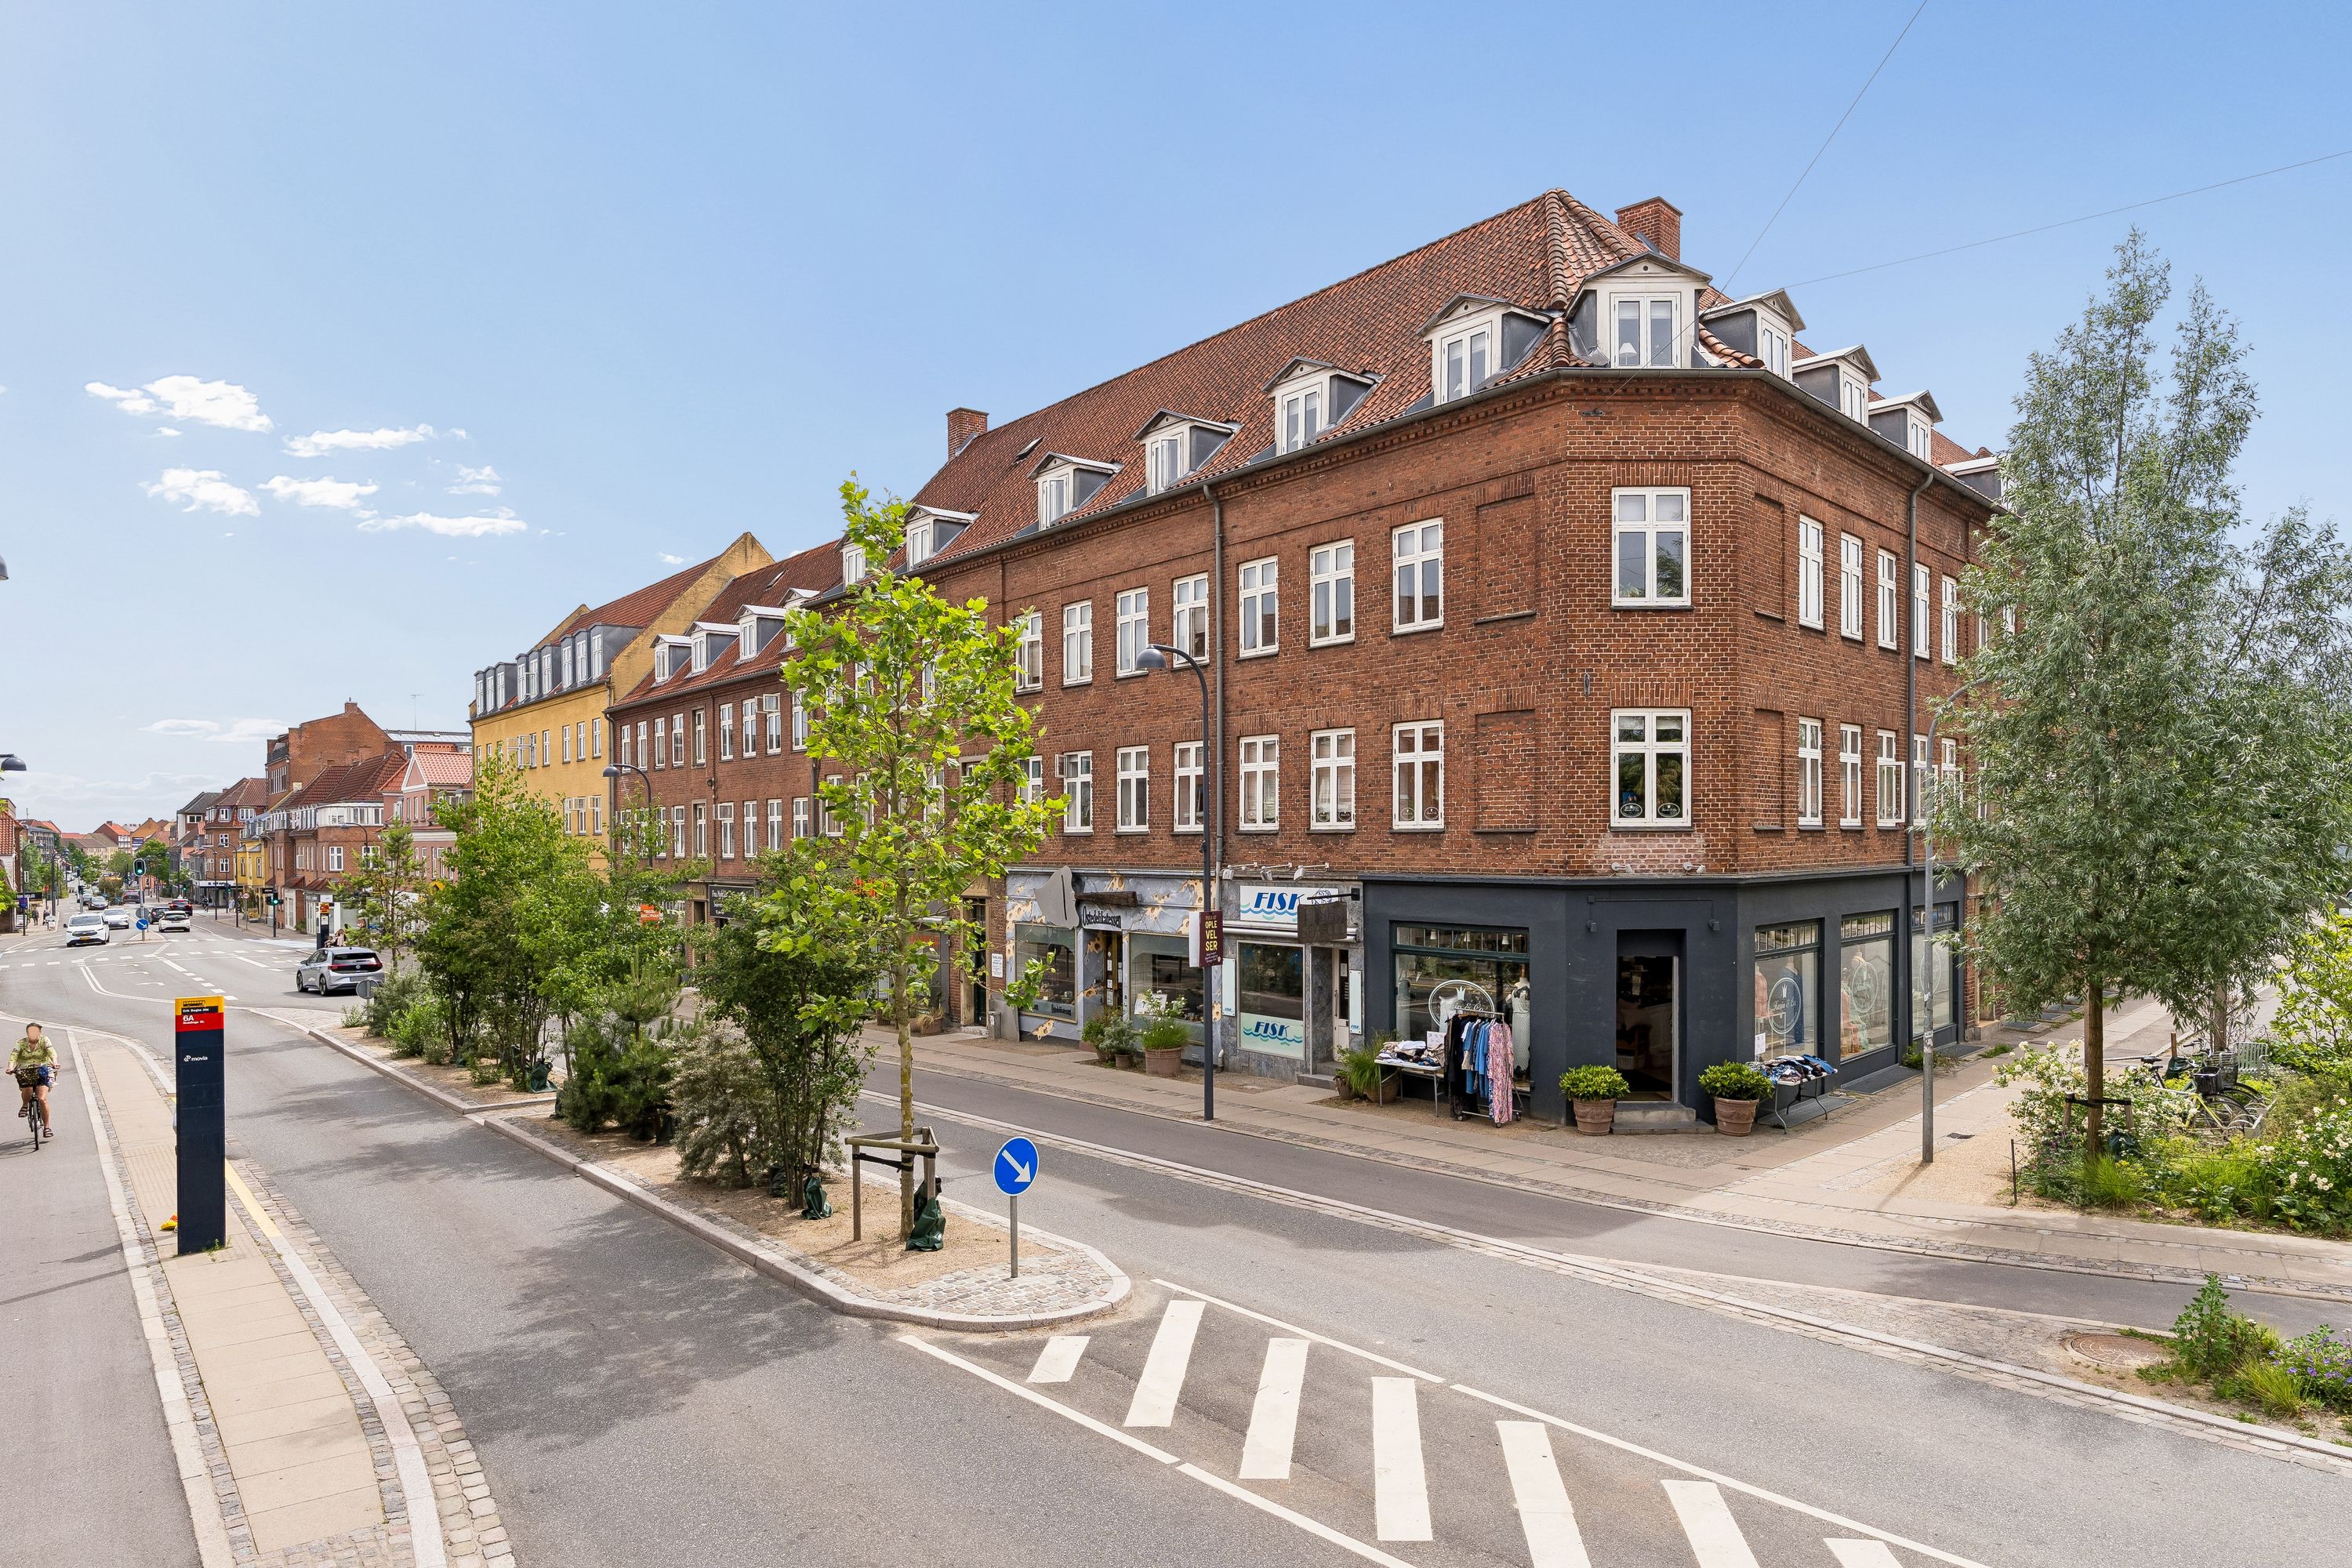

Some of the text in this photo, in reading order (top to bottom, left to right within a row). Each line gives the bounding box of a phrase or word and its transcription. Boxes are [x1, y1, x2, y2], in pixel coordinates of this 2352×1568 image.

[1254, 892, 1305, 910] FISK
[1205, 920, 1218, 929] OPLE
[1205, 929, 1218, 939] VEL
[1205, 940, 1218, 951] SER
[1254, 1021, 1290, 1037] FISK
